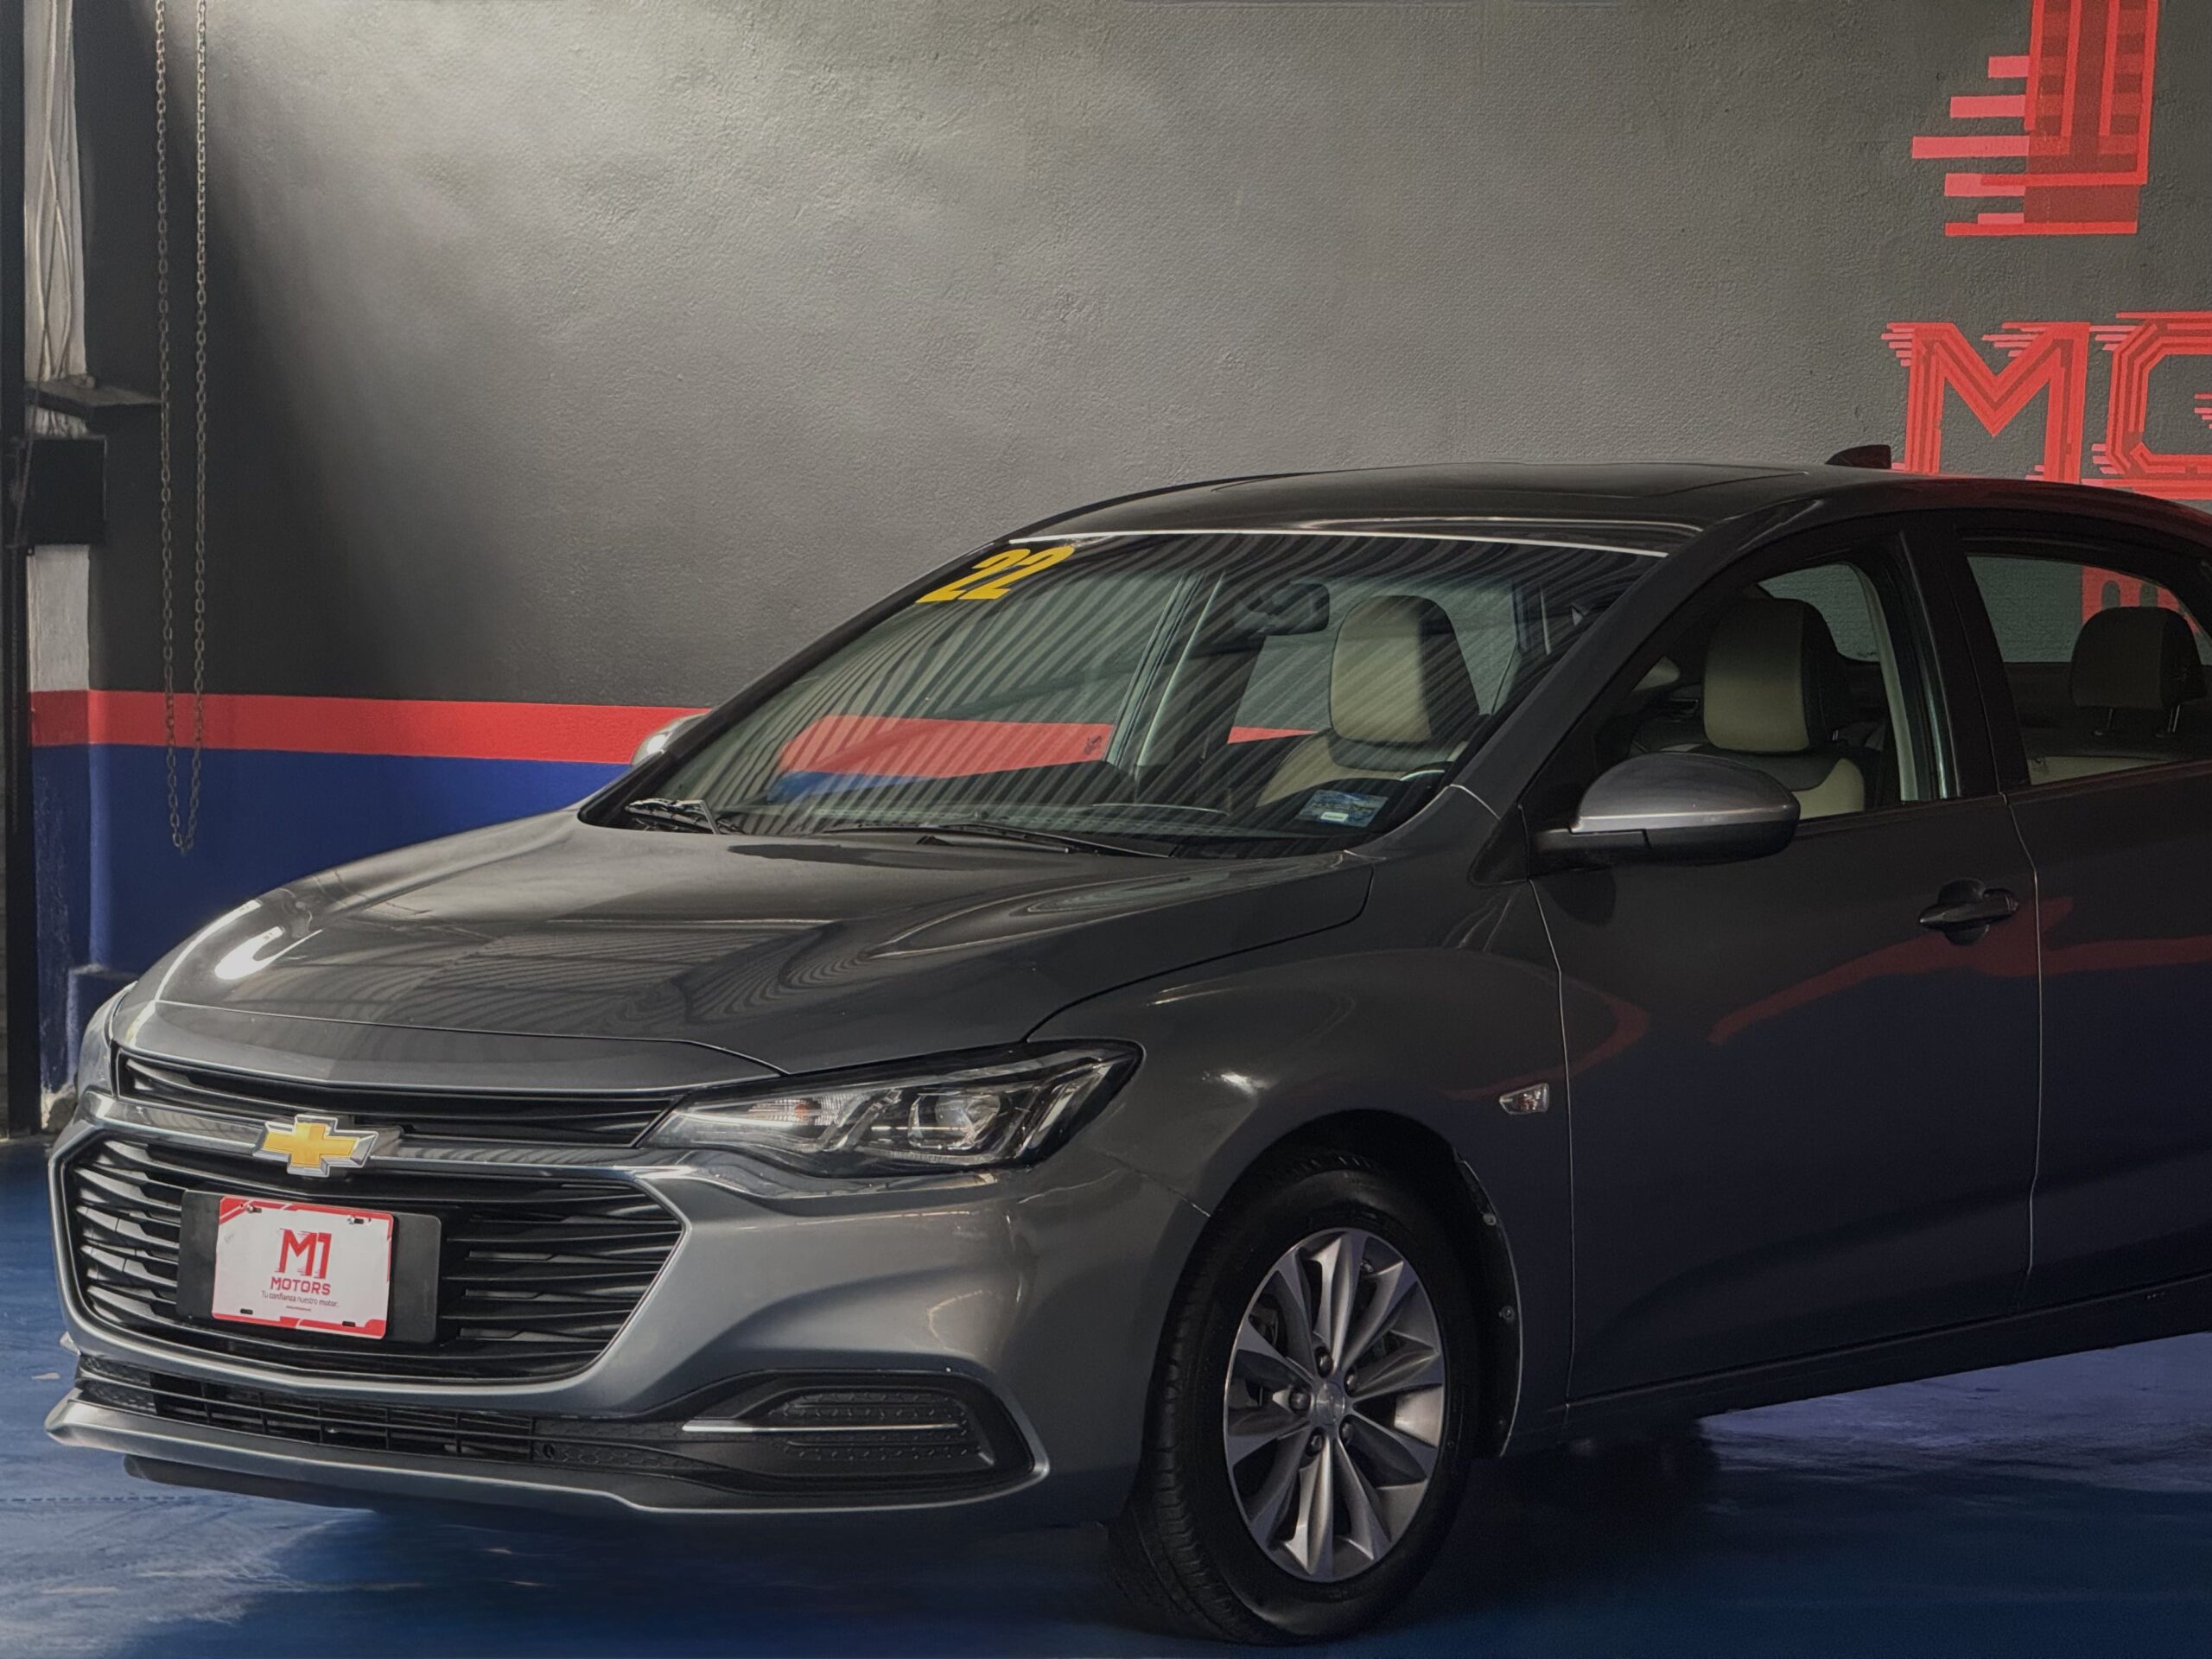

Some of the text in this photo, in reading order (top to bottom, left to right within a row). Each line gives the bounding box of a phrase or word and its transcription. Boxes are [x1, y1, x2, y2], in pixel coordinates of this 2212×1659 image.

[915, 545, 1075, 603] 22
[276, 1228, 332, 1279] M1
[270, 1276, 331, 1296] MOTORS
